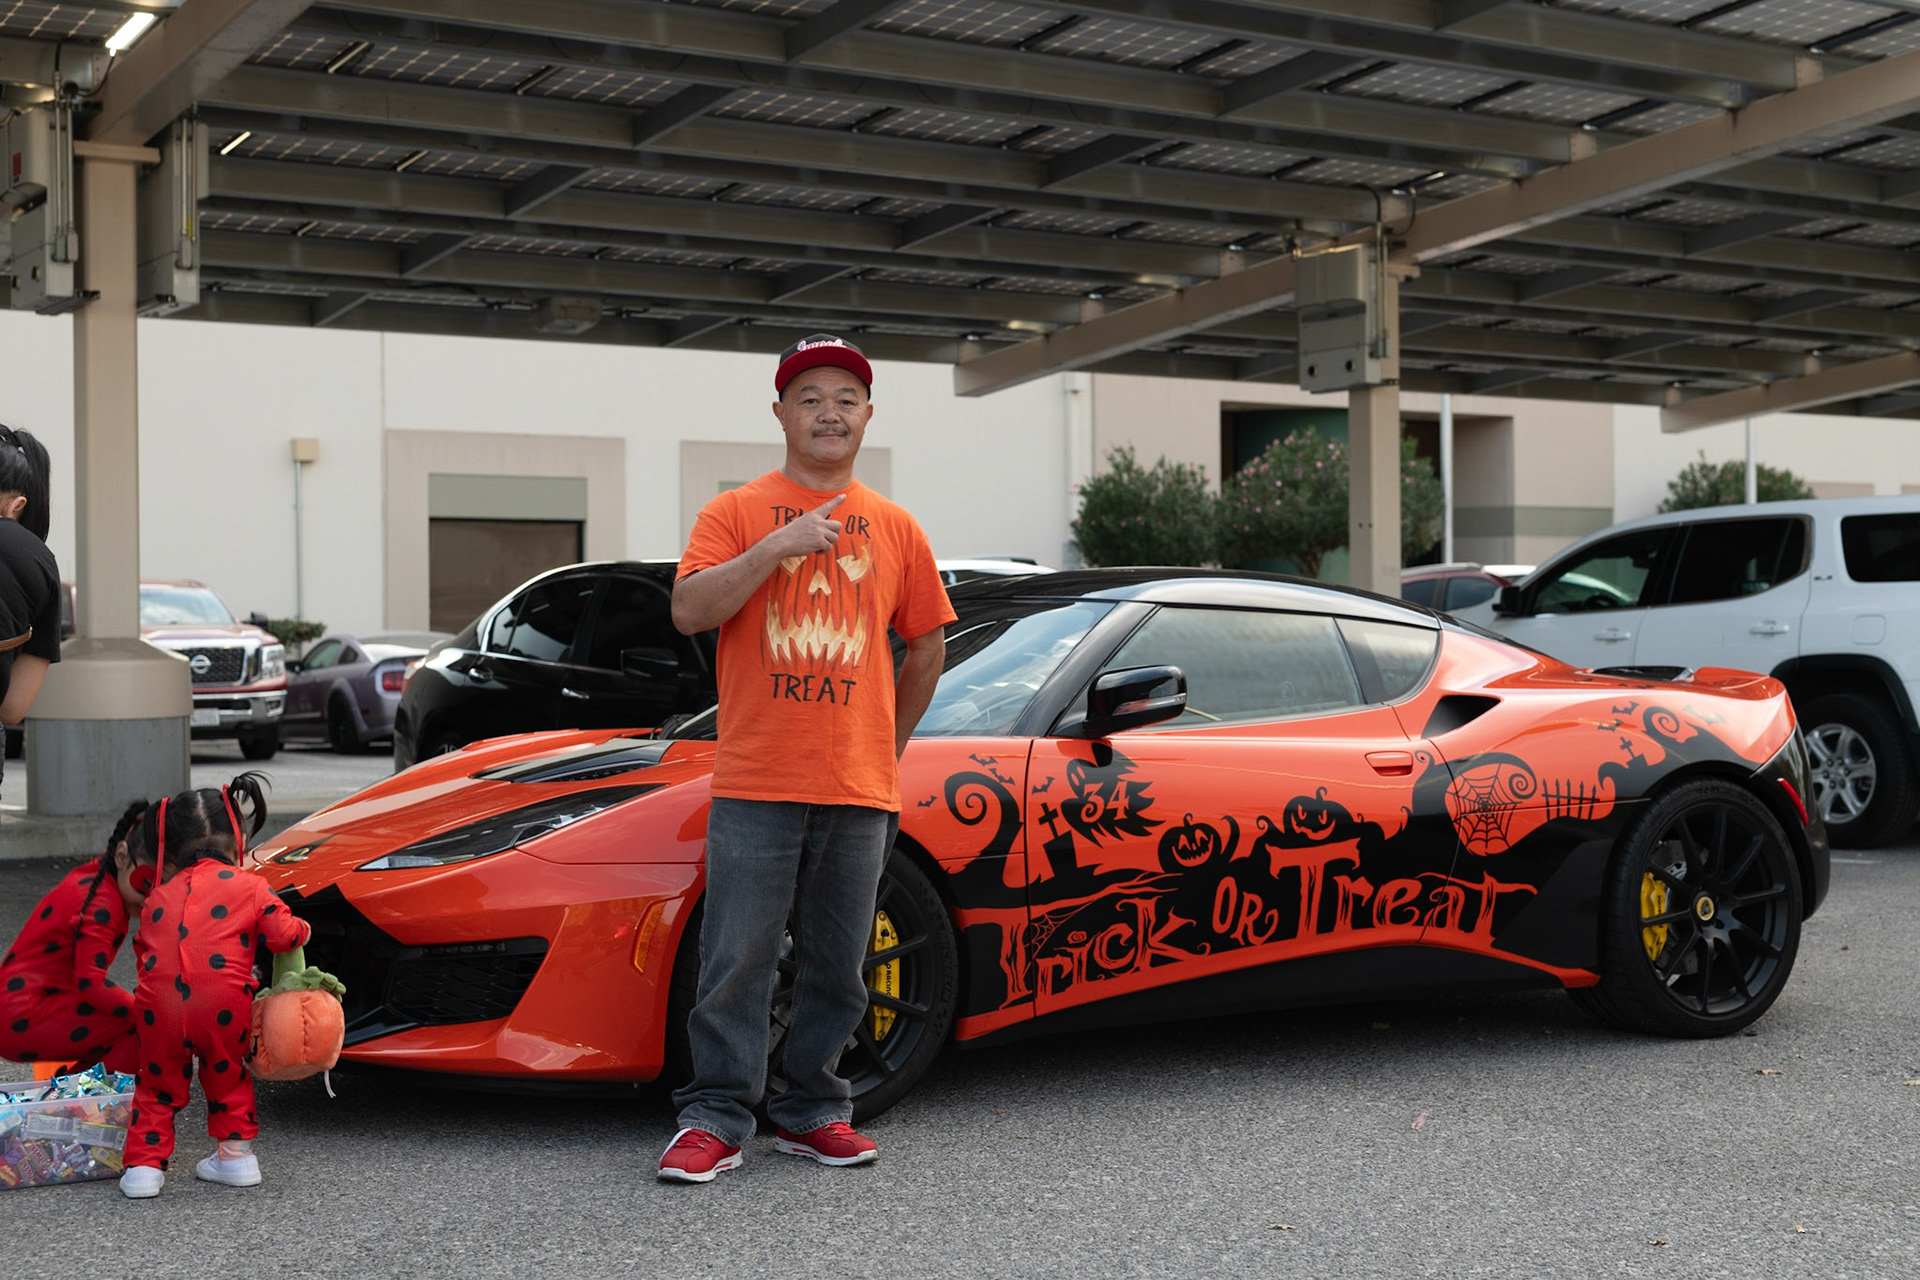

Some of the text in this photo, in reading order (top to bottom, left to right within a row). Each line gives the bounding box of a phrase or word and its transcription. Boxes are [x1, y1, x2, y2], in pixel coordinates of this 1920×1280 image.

[845, 514, 871, 539] OR
[770, 673, 857, 705] TREAT
[1081, 781, 1130, 823] 34
